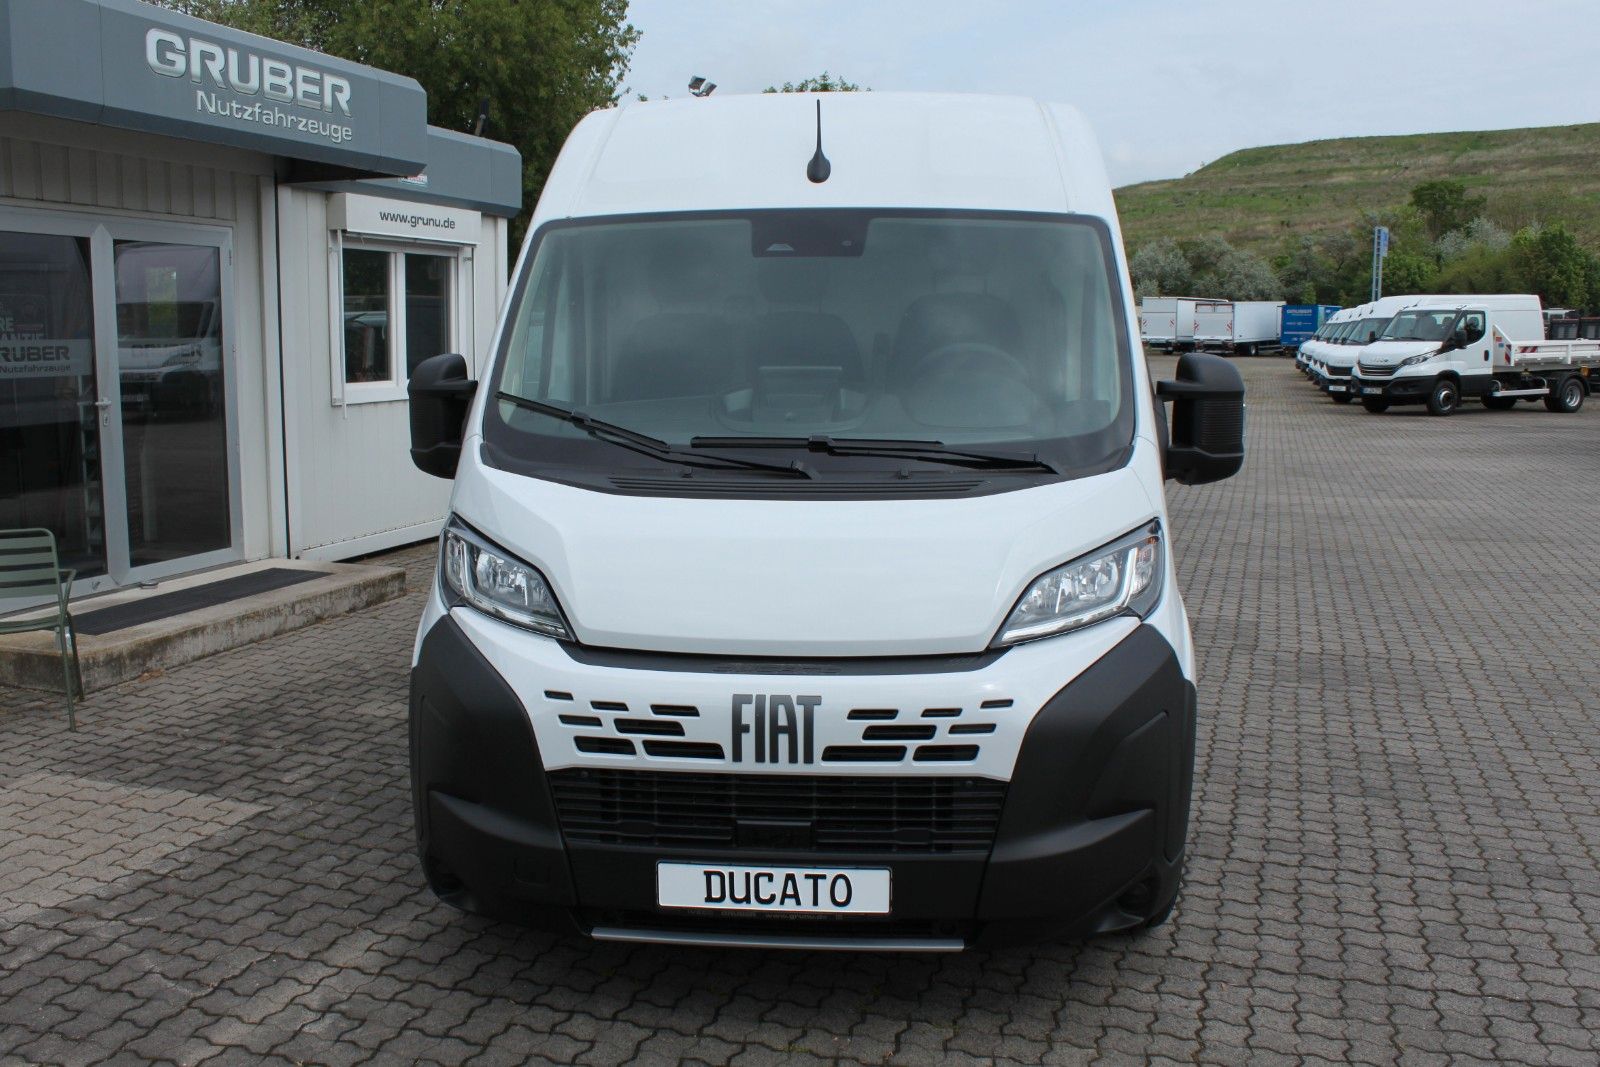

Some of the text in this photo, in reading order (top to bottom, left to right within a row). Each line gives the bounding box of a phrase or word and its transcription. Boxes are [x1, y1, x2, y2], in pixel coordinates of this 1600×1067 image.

[145, 28, 352, 117] GRUBER
[196, 89, 353, 143] Nutzfahrzeuge
[379, 210, 456, 230] www.grunu.de
[732, 694, 822, 764] FIAT
[704, 870, 853, 908] DUCATO
